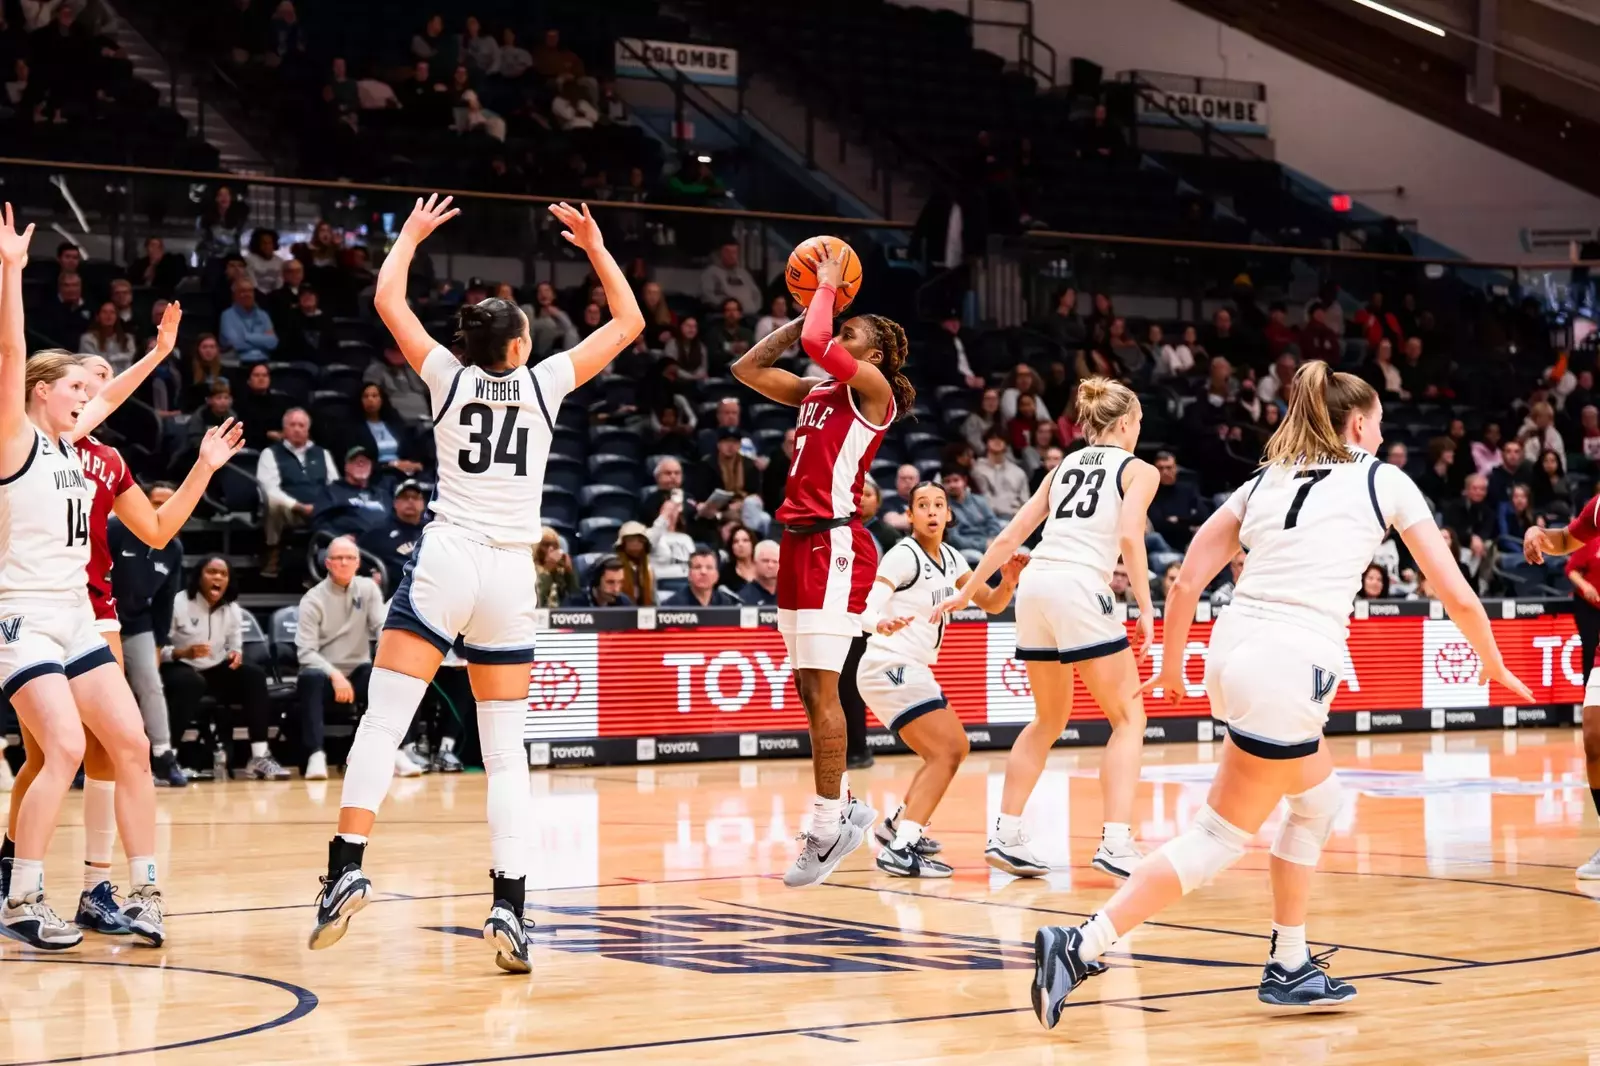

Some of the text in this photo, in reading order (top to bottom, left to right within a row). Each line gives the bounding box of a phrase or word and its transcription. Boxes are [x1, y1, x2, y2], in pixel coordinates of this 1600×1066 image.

[642, 44, 730, 70] COLOMBE
[1165, 95, 1257, 122] COLOMBE
[475, 377, 521, 401] WEBBER
[797, 402, 835, 430] MPLE
[458, 402, 530, 476] 34
[790, 435, 807, 477] 7
[73, 446, 116, 491] MPLE
[1055, 468, 1107, 519] 23
[1283, 468, 1333, 530] 7
[66, 498, 88, 547] 14
[658, 612, 698, 624] TOYOTA
[1370, 605, 1400, 616] TOYOTA
[1516, 604, 1545, 615] TOYOTA
[552, 613, 594, 625] TOYOTA
[1372, 714, 1402, 726] TOYOTA
[1446, 712, 1476, 723] TOYOTA
[1518, 710, 1547, 721] TOYOTA
[552, 746, 595, 759] TOYOTA
[658, 742, 700, 754] TOYOTA
[759, 738, 800, 750] TOYOTA
